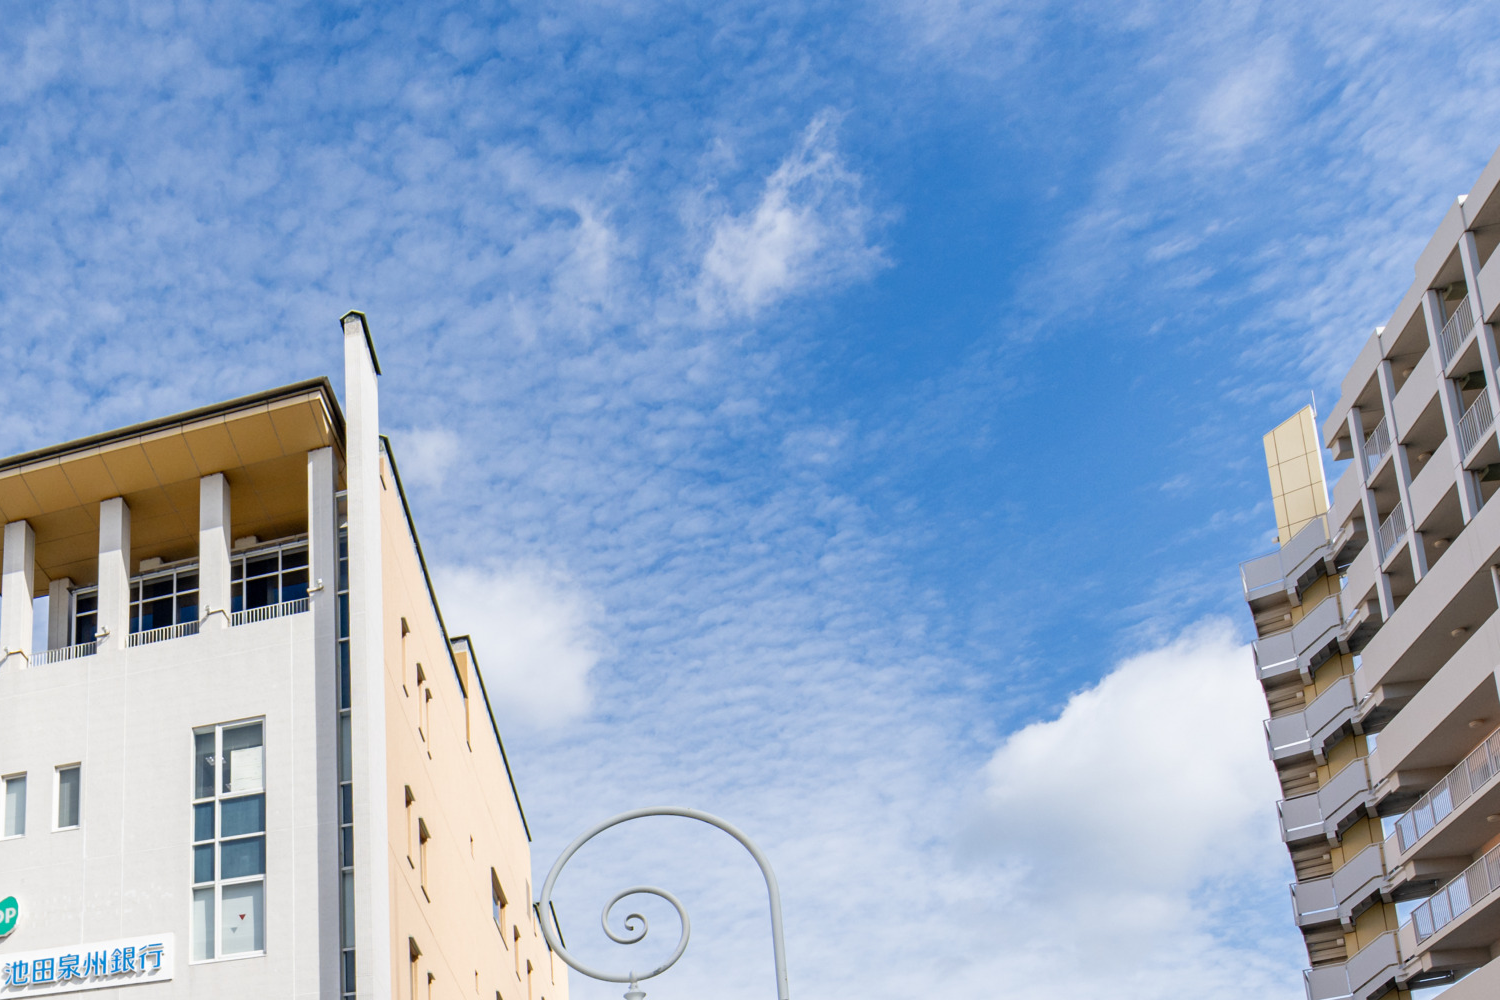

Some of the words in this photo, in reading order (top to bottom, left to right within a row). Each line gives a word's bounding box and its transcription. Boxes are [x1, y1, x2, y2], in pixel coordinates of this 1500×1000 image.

[4, 943, 164, 986] 池田泉州銀行
